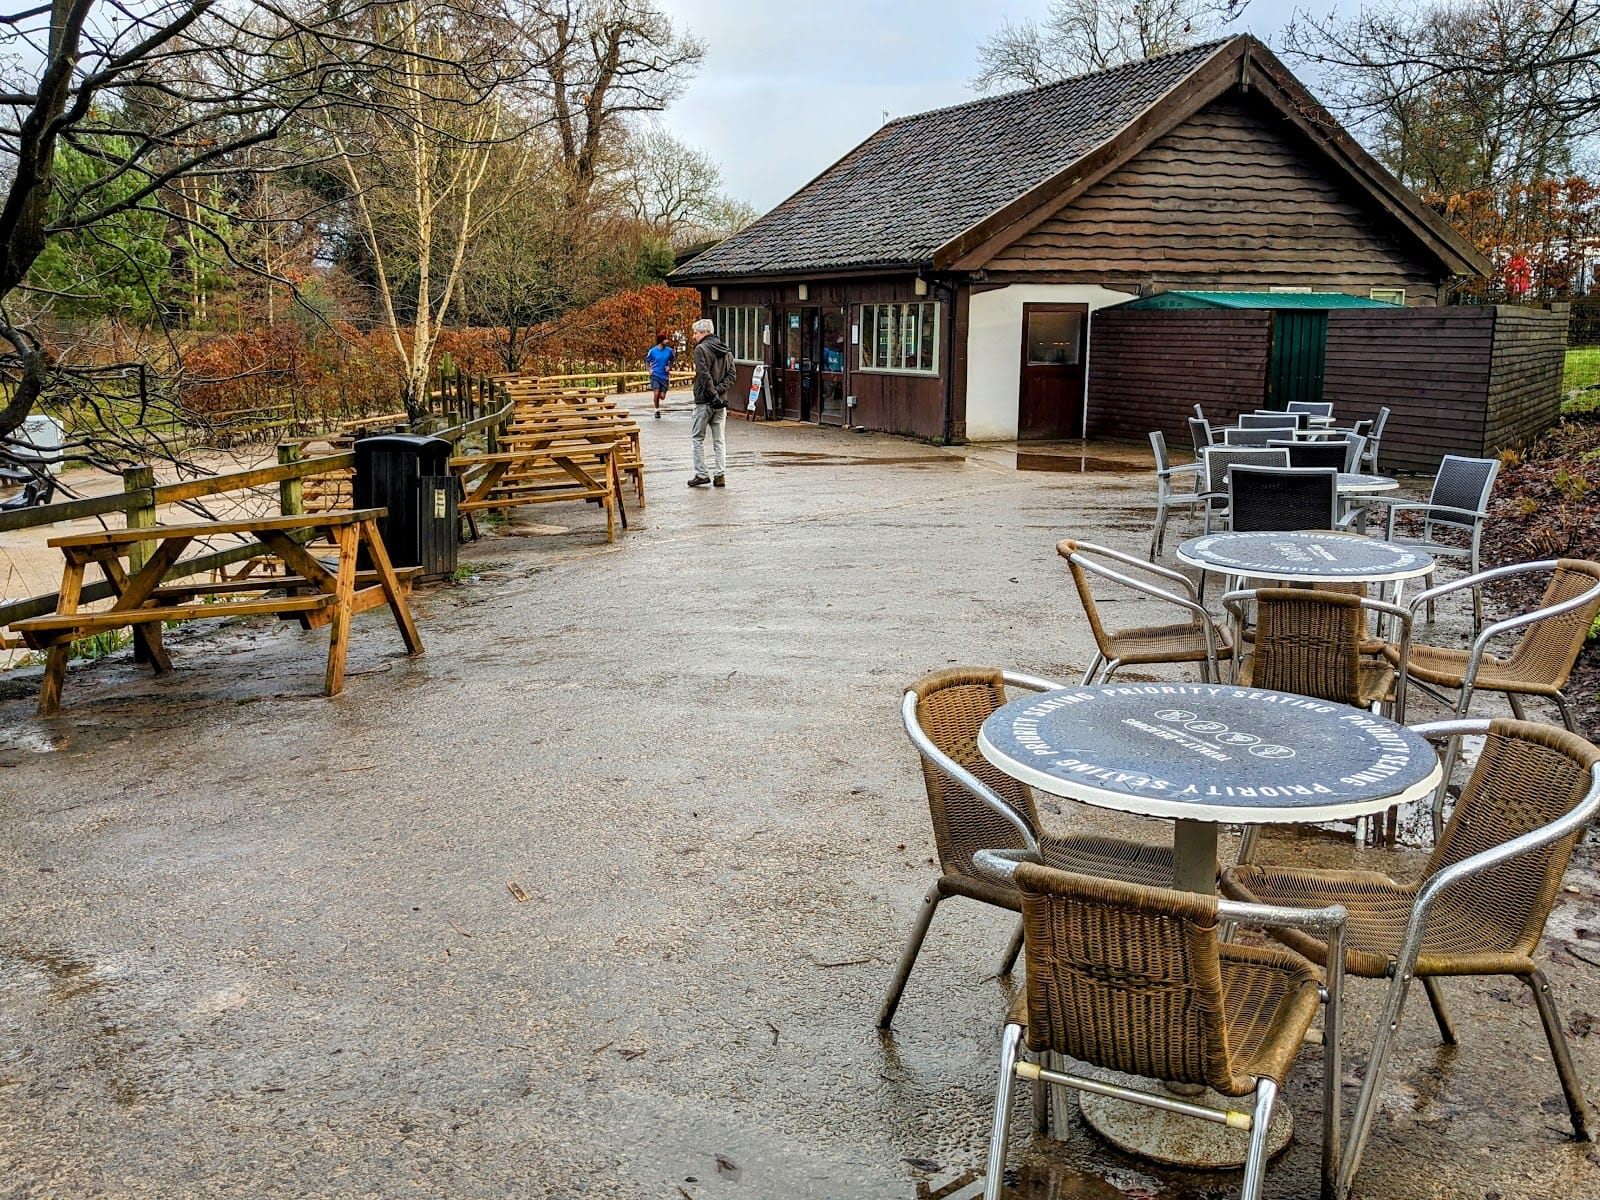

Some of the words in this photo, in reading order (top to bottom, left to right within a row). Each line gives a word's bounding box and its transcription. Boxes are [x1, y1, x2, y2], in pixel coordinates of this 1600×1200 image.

[1022, 692, 1095, 717] SEATING
[1102, 686, 1220, 697] PRIORITY
[1232, 690, 1336, 713] SEATING
[1012, 716, 1060, 755] PRIORITY
[1338, 715, 1410, 753] PRIORITY
[1181, 742, 1233, 761] TOTALLY
[1056, 759, 1169, 789] SEATING
[1339, 754, 1410, 787] SEATING
[1182, 782, 1333, 797] PRIORITY
